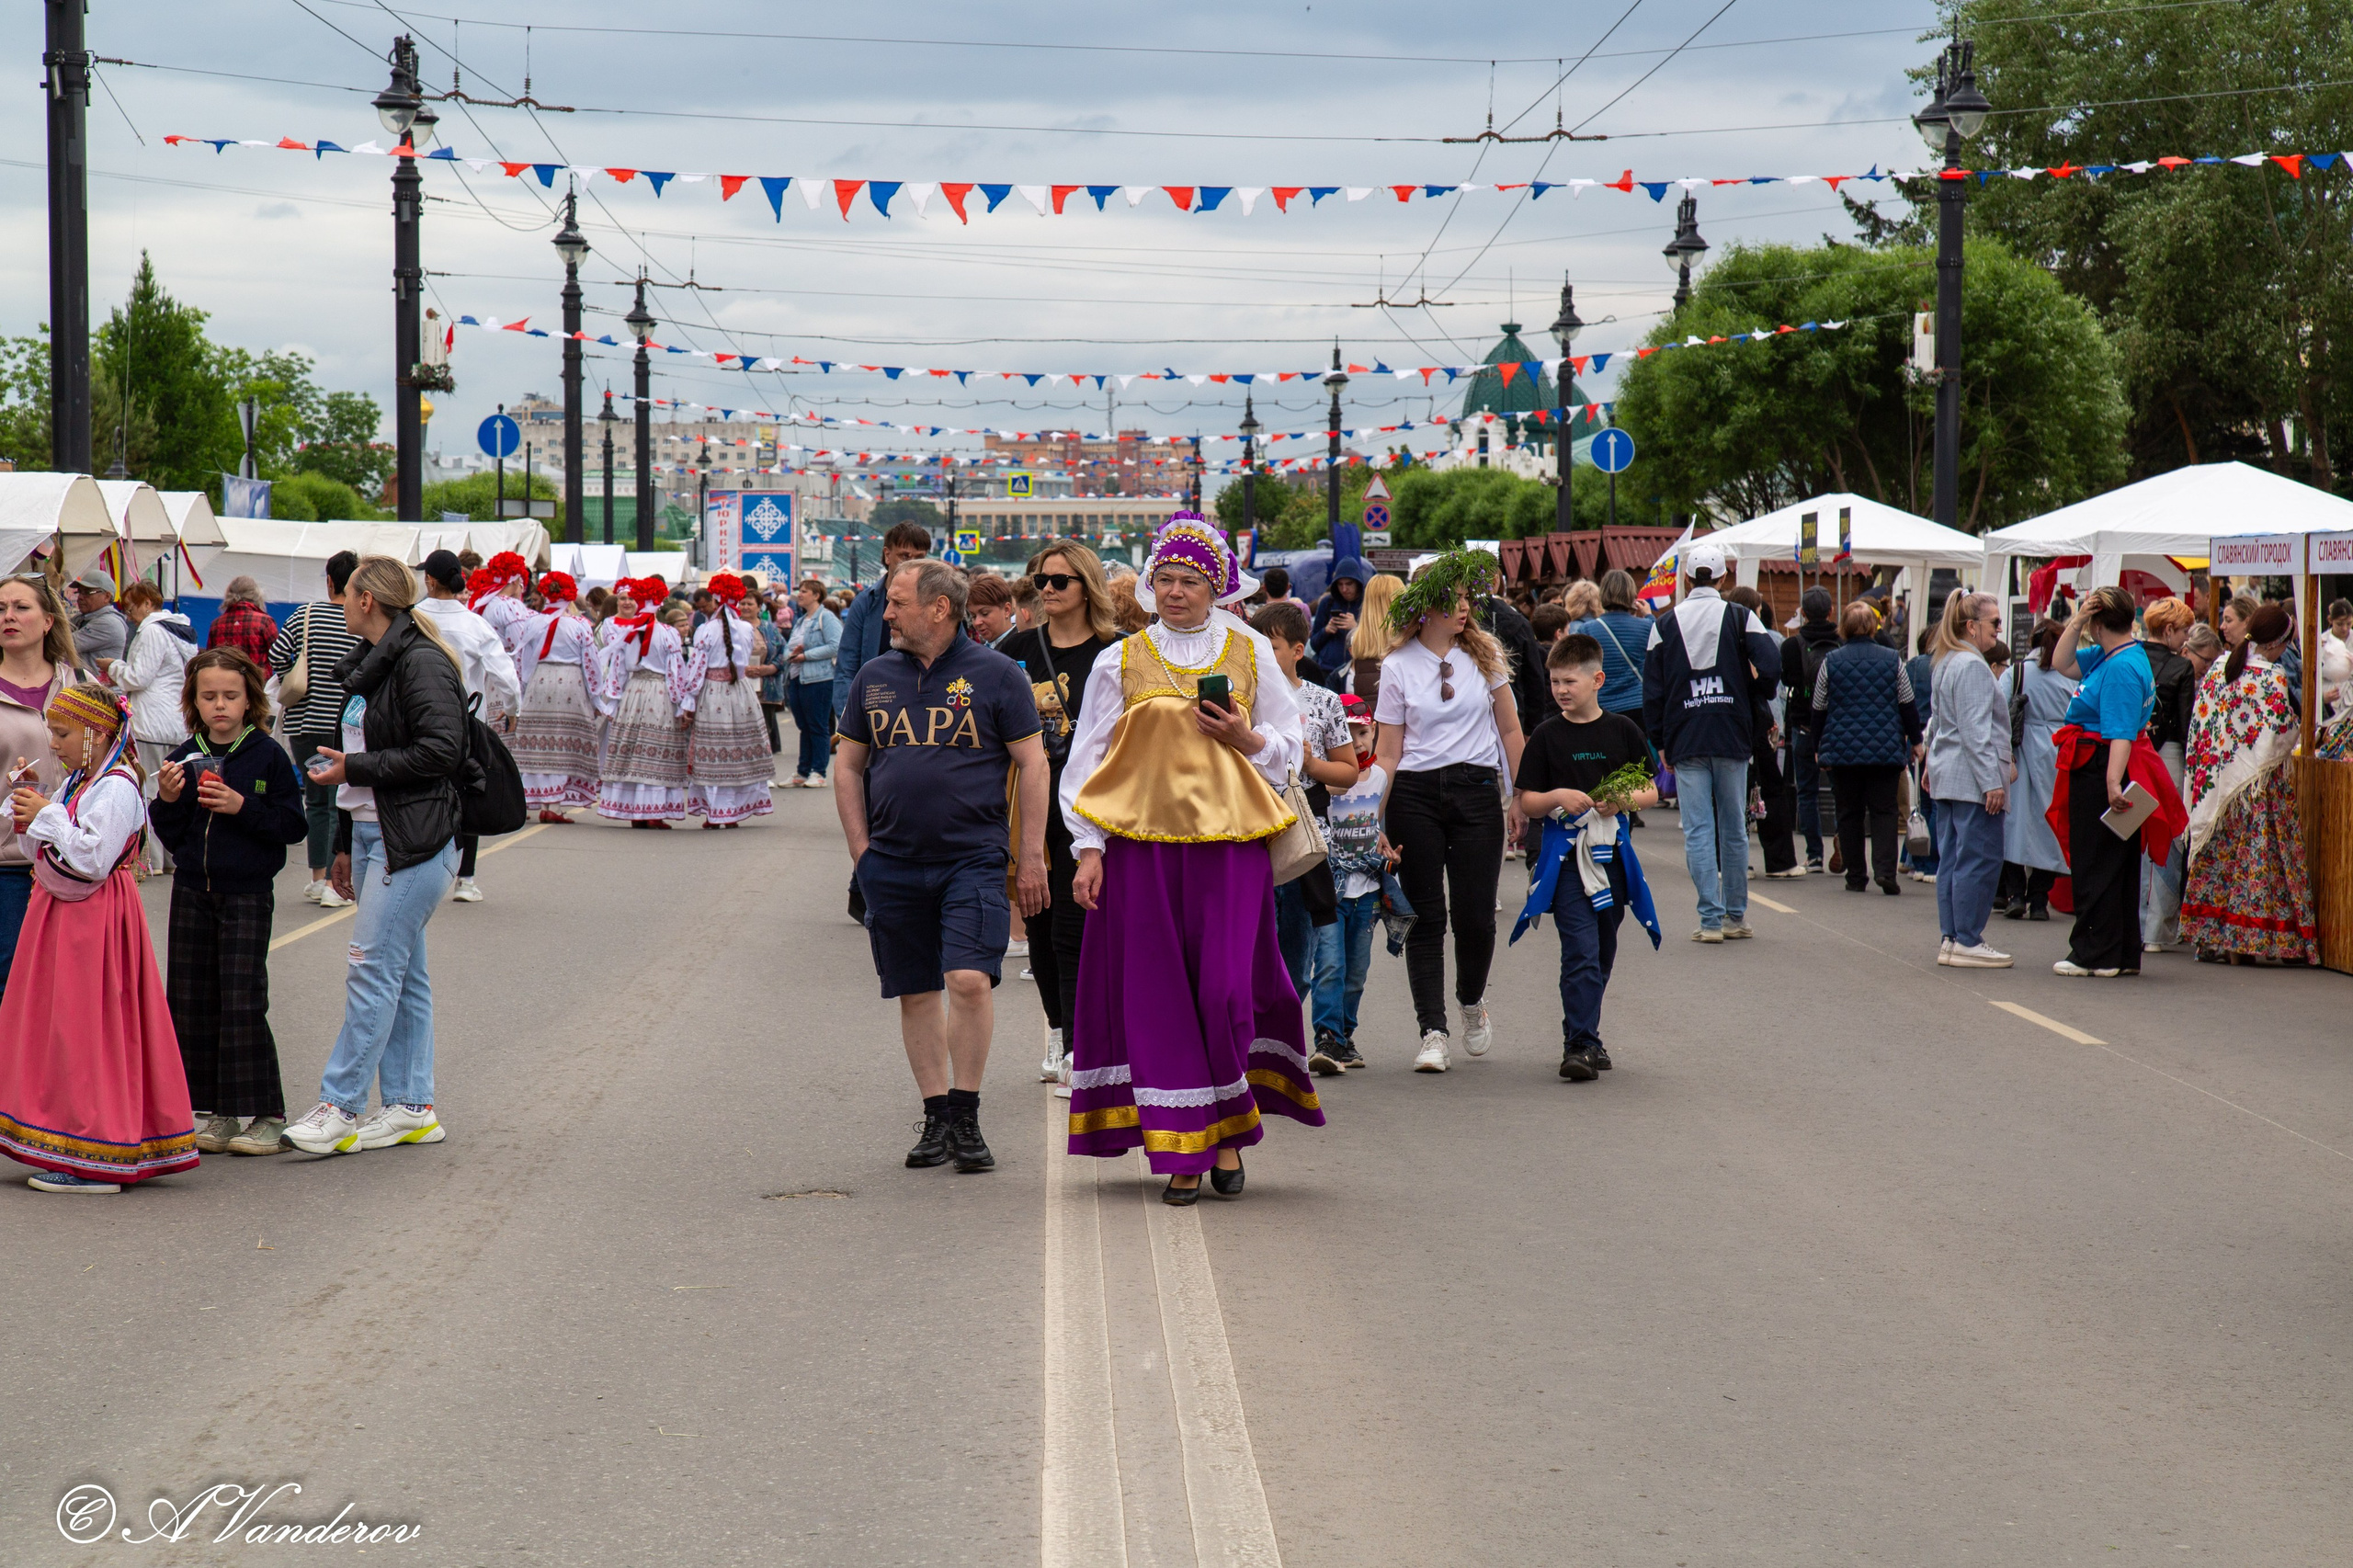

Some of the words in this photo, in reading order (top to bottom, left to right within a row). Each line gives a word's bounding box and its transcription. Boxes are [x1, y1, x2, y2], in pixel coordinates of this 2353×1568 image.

[2217, 539, 2259, 564] СЛАВЯНСКИЙ
[2260, 542, 2292, 568] ГОРОДОК
[2318, 540, 2353, 562] СЛАВЯНС
[1689, 676, 1724, 698] HH
[867, 706, 983, 749] PAPA
[1572, 752, 1607, 761] VIRTUAL
